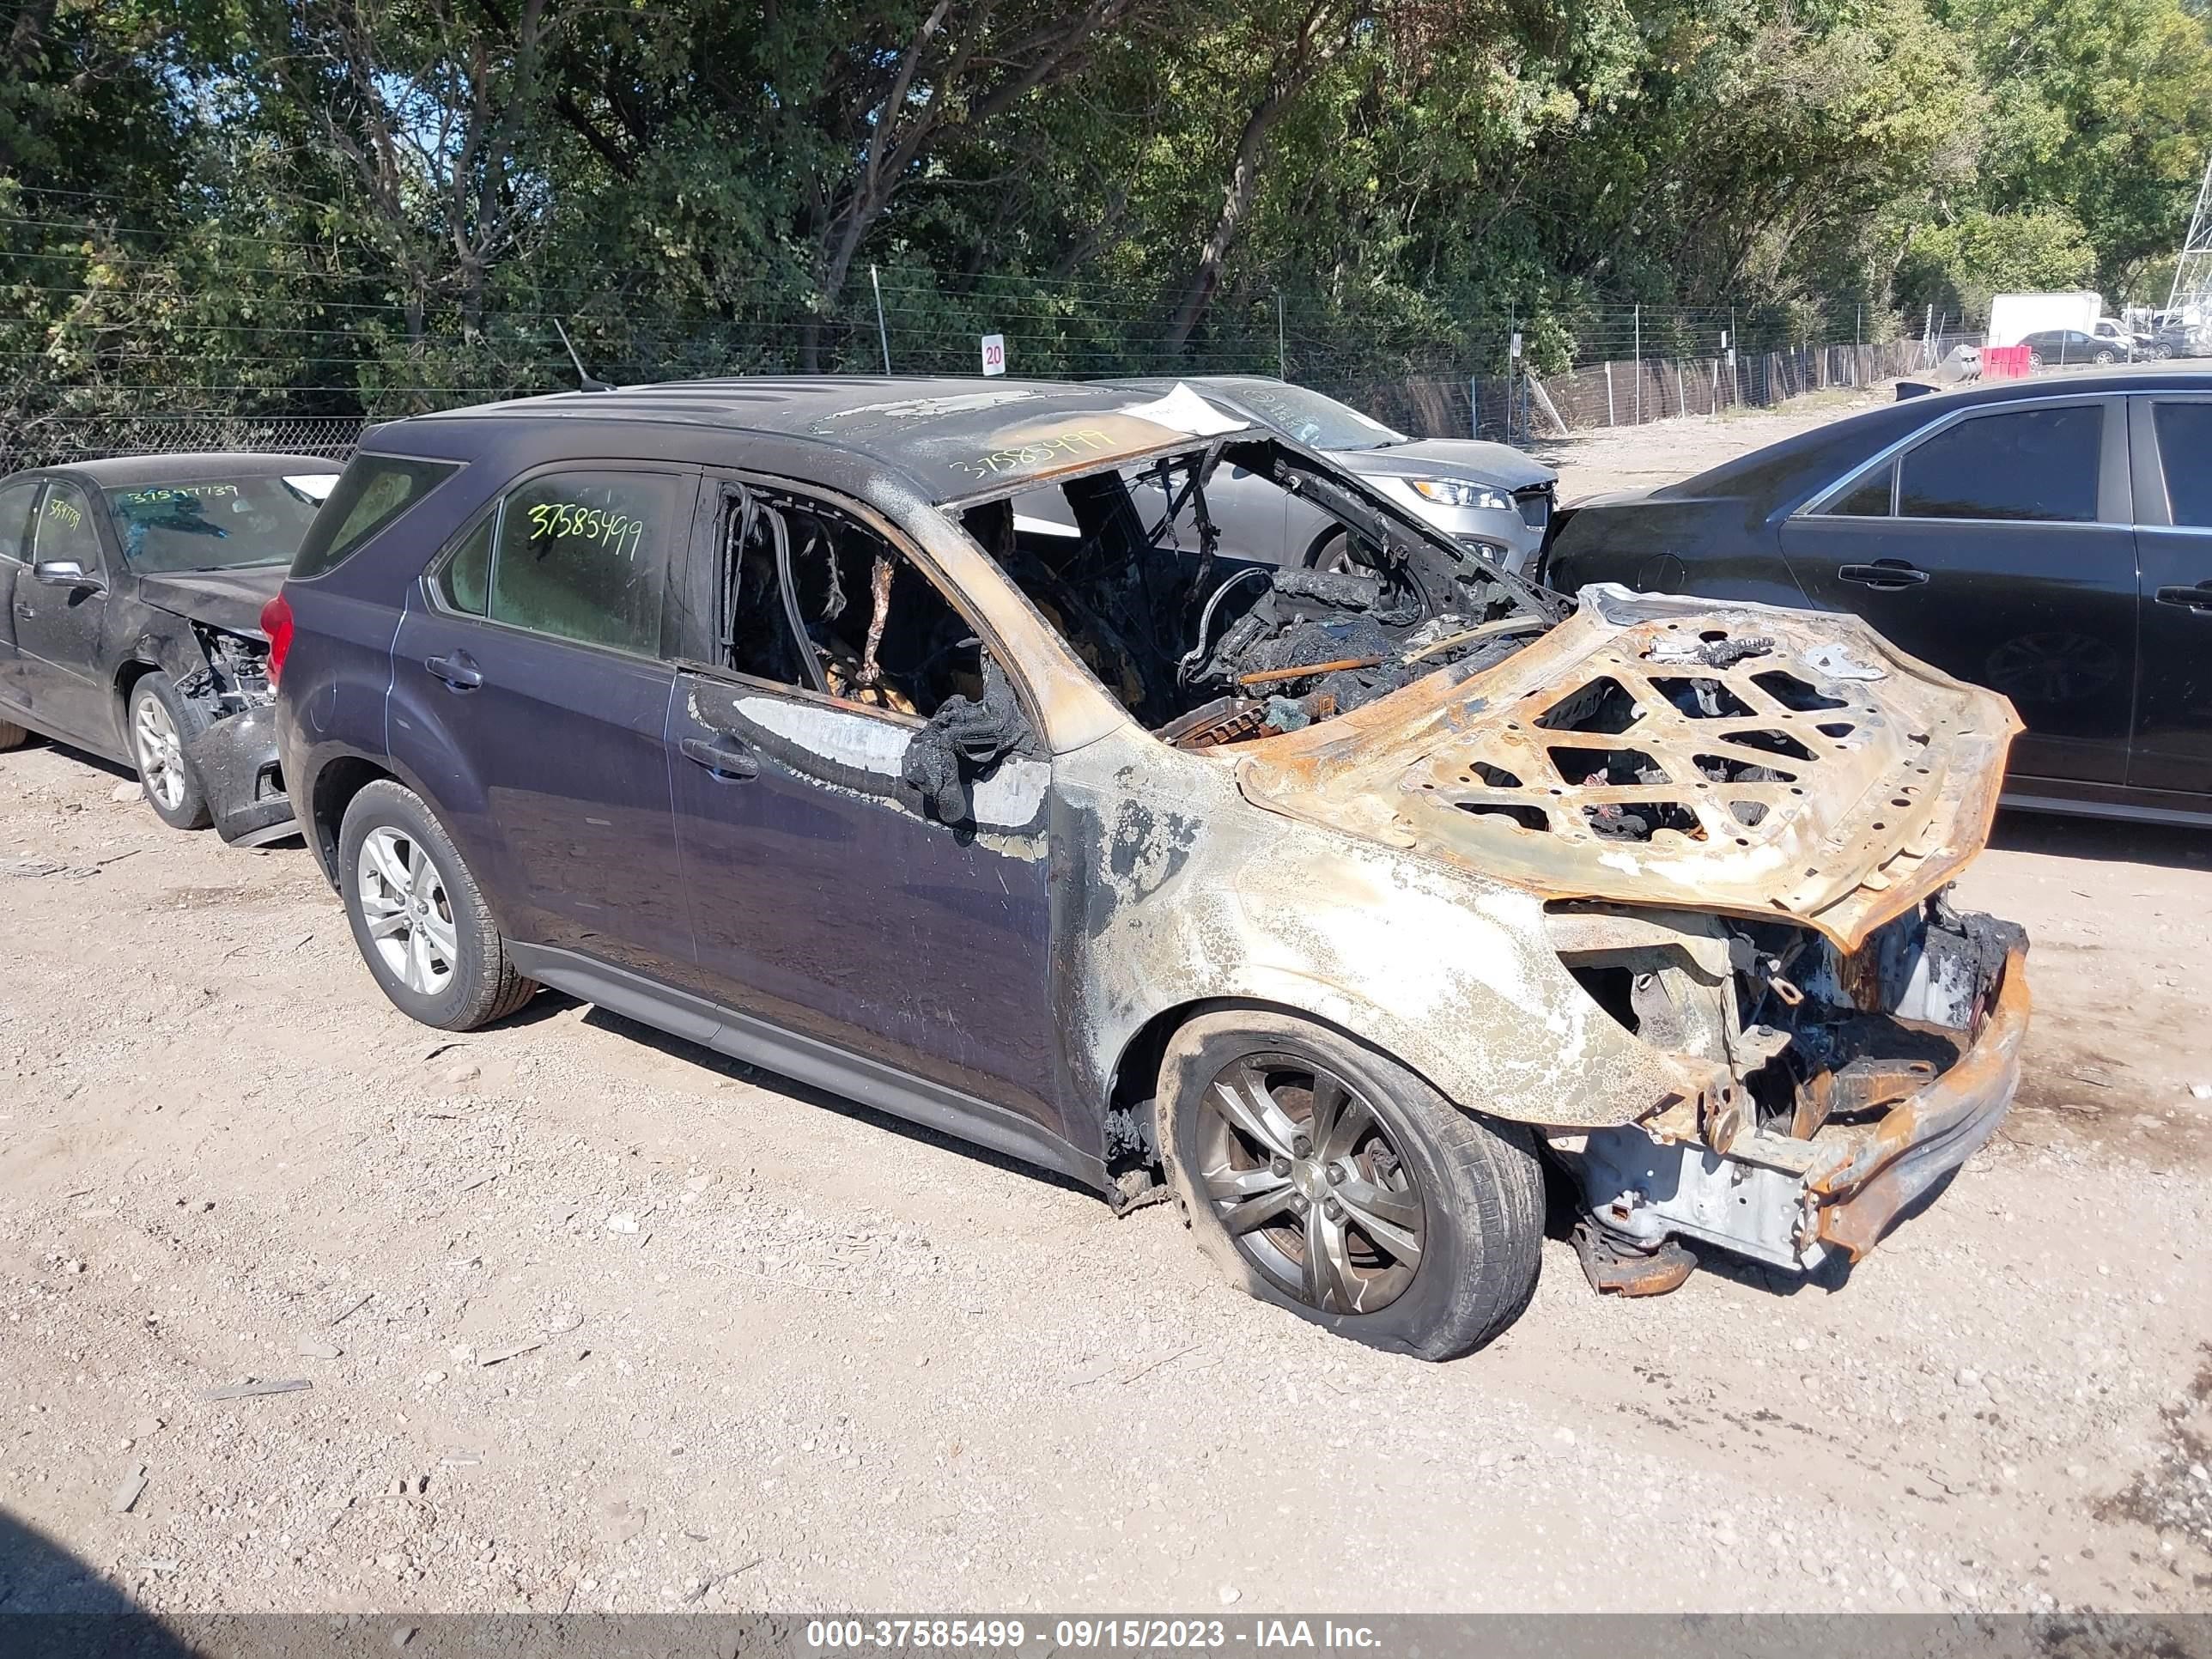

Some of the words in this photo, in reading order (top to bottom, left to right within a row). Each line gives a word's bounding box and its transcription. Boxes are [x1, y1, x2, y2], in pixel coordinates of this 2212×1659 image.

[986, 345, 1001, 365] 20
[949, 429, 1115, 479] 37585499
[527, 503, 643, 562] 37585499
